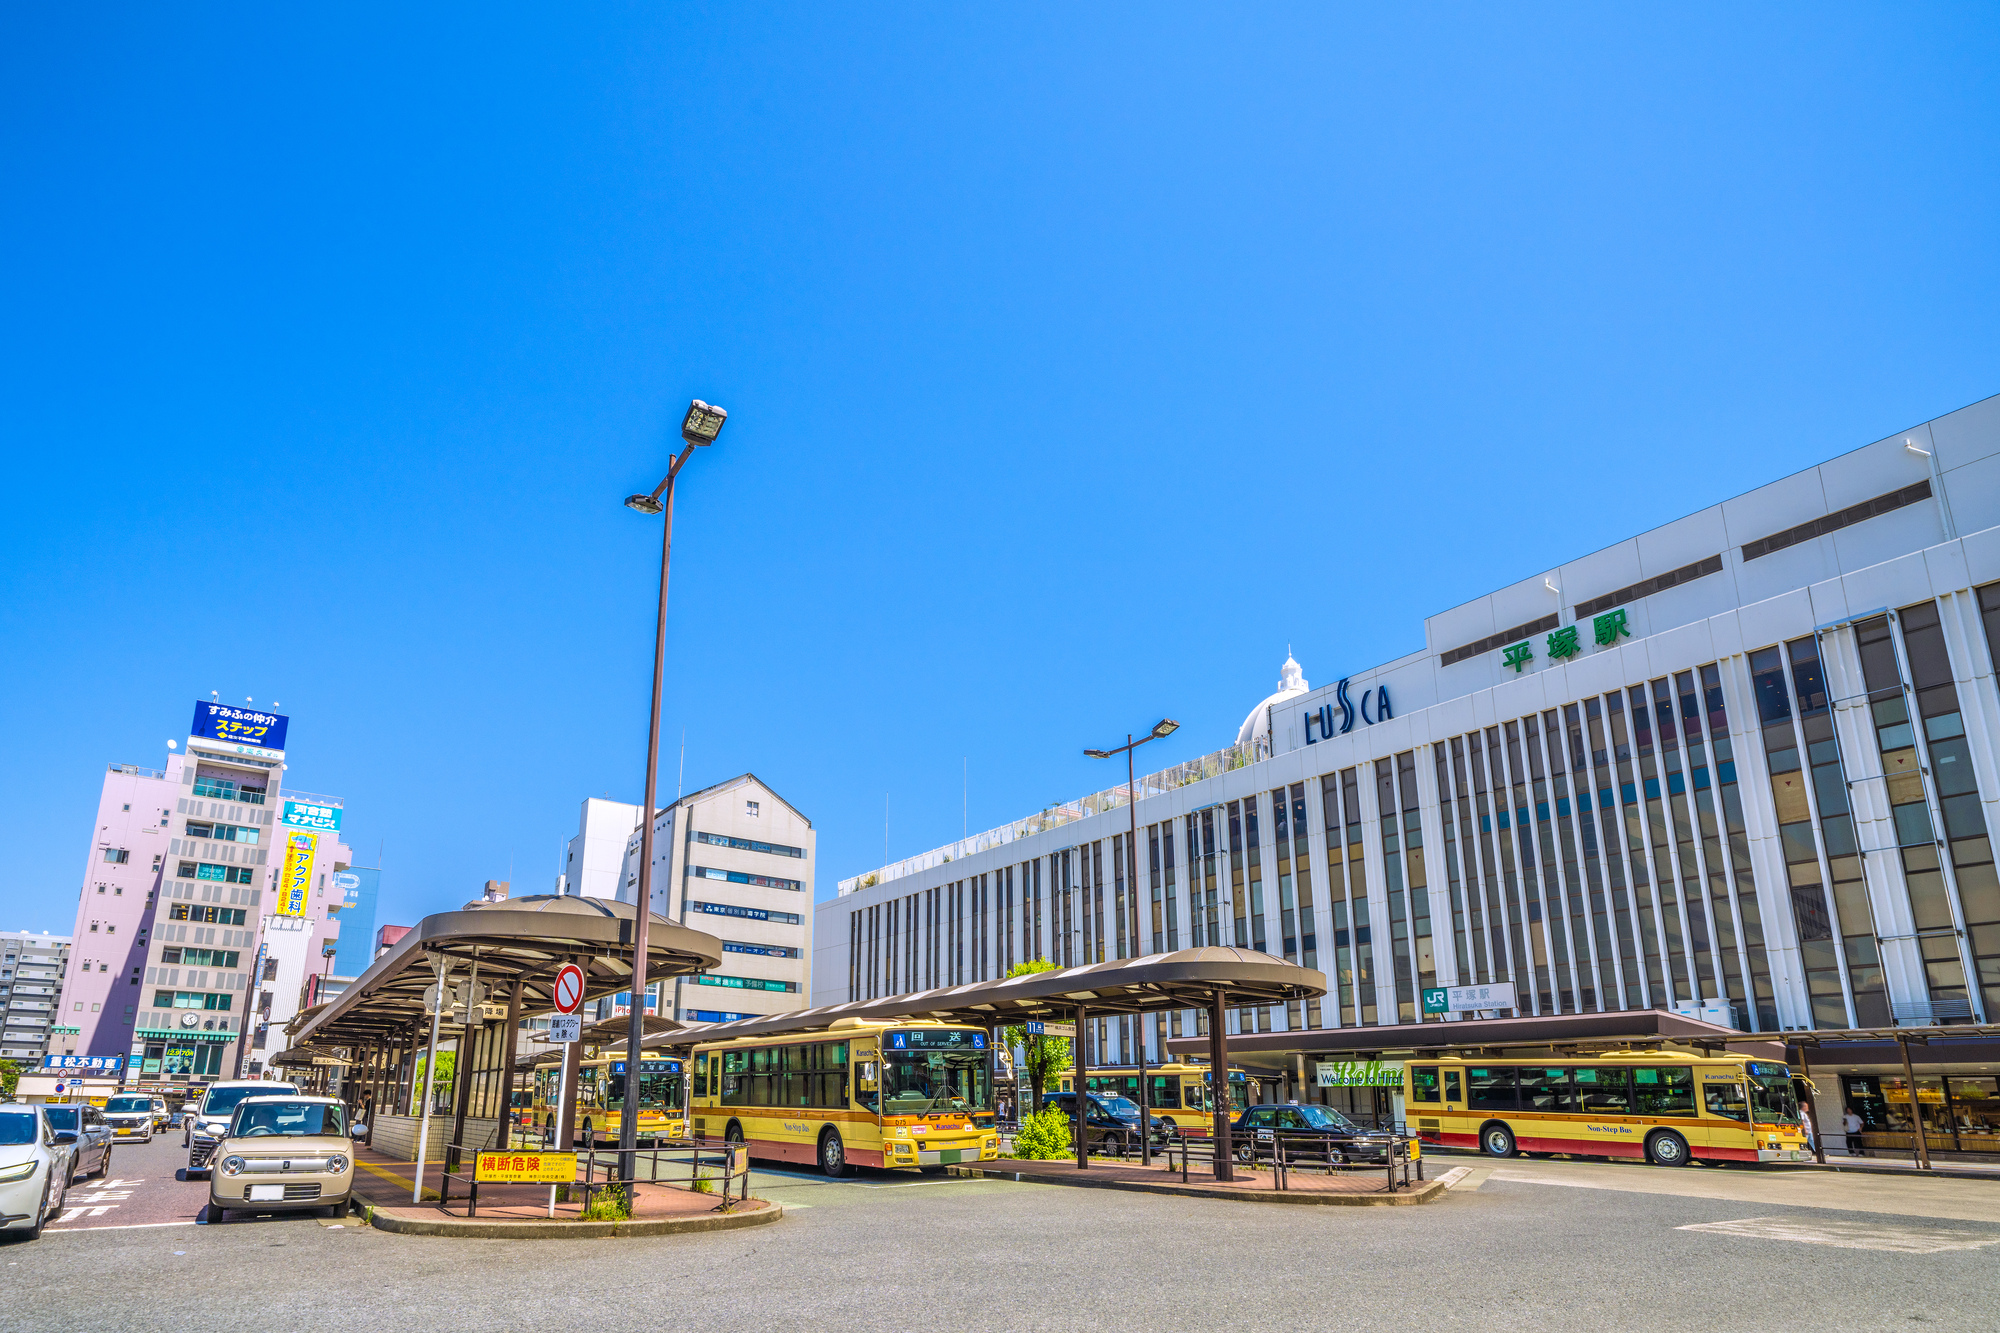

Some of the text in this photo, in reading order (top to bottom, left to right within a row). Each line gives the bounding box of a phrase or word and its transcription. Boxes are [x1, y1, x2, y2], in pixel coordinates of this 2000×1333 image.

[1502, 608, 1630, 673] 平塚駅
[208, 705, 278, 726] すみふの仲介
[1304, 678, 1393, 745] LUSCA
[216, 719, 268, 737] ステップ
[294, 804, 333, 819] 河合塾
[287, 814, 336, 829] マナビス
[287, 853, 310, 913] アクア歯科
[713, 906, 766, 919] 東京個別指導学院
[1427, 991, 1445, 1004] JR
[1452, 988, 1490, 1001] 平塚駅
[556, 1029, 573, 1039] を除く
[1028, 1022, 1036, 1033] 11
[911, 1031, 961, 1042] 回送
[49, 1056, 117, 1069] 重松不動産
[1321, 1073, 1404, 1085] Welcome to Hirat
[802, 1123, 810, 1132] Bus
[1587, 1124, 1633, 1135] Non-Step Bus
[482, 1156, 541, 1172] 横断危険
